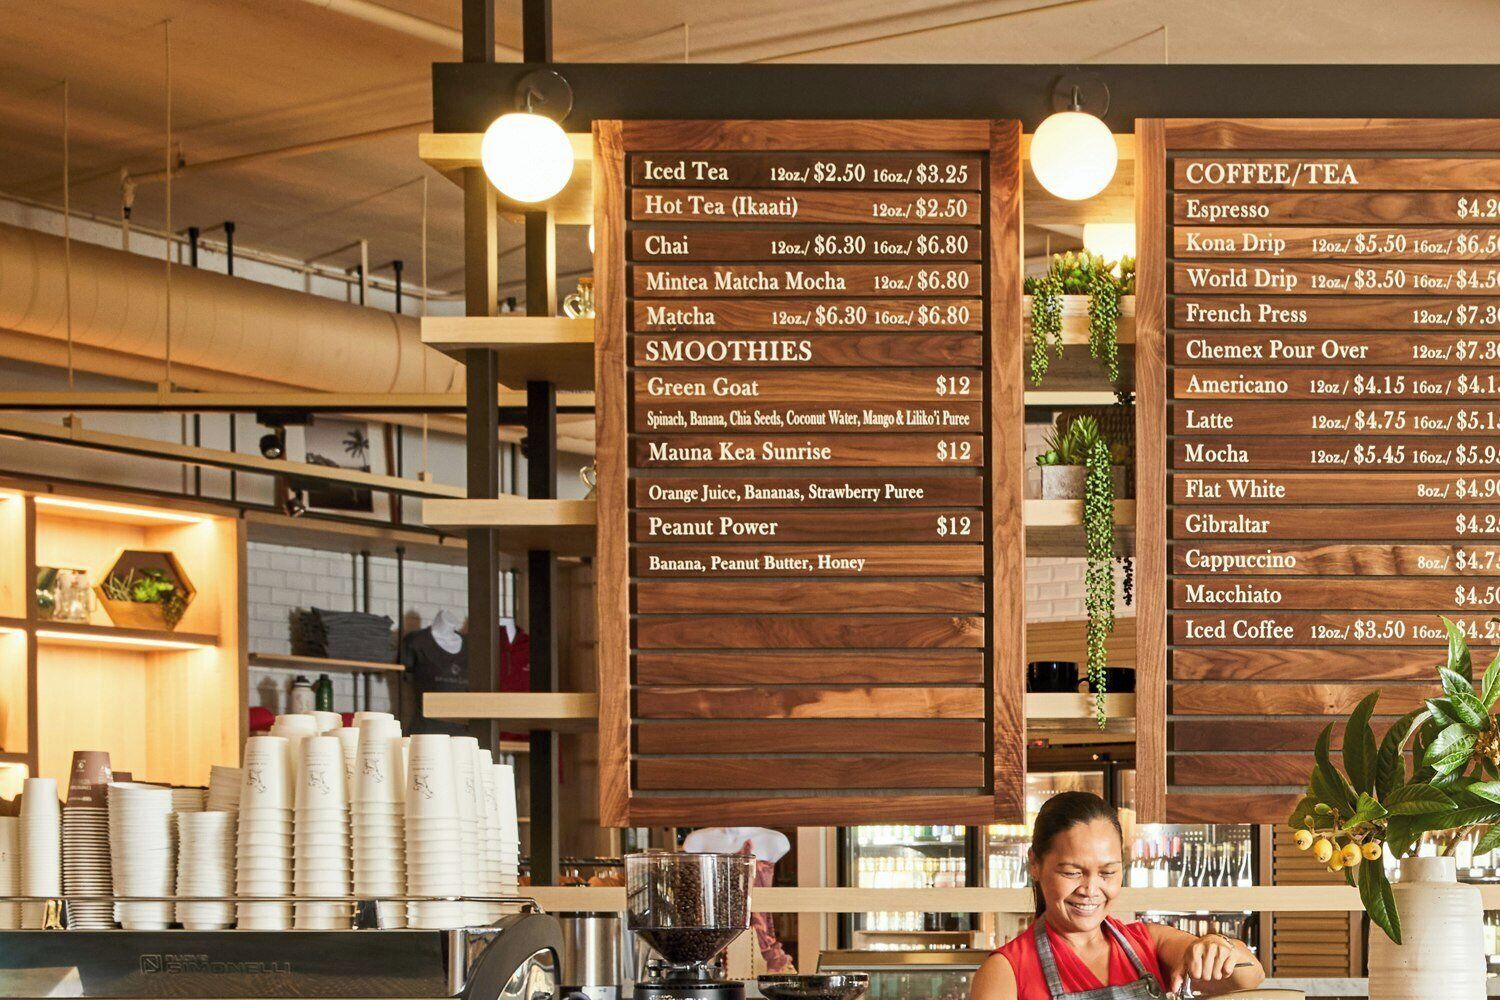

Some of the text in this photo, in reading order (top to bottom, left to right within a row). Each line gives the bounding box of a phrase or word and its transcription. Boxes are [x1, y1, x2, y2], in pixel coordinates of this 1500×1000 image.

[645, 161, 685, 180] Iced
[692, 162, 729, 180] Tea
[814, 162, 865, 183] $2.50
[917, 163, 967, 184] $3.25
[1187, 163, 1359, 186] COFFEE/TEA
[645, 195, 682, 214] Hot
[688, 196, 725, 214] Tea
[732, 196, 798, 217] (Ikaati)
[916, 197, 967, 218] $2.50
[1187, 200, 1269, 222] Espresso
[645, 236, 688, 254] Chai
[815, 235, 865, 255] $6.30
[917, 234, 968, 255] $6.80
[1187, 233, 1235, 251] Kona
[1242, 233, 1285, 255] Drip
[1355, 233, 1406, 254] $5.50
[647, 272, 708, 290] Mintea
[715, 272, 779, 290] Matcha
[786, 271, 846, 289] Mocha
[918, 269, 969, 290] $6.80
[1187, 269, 1247, 287] World
[1255, 269, 1297, 291] Drip
[1355, 269, 1405, 289] $3.50
[647, 306, 715, 324] Matcha
[816, 305, 866, 326] $6.30
[918, 305, 969, 326] $6.80
[1187, 304, 1251, 322] French
[1259, 304, 1307, 322] Press
[646, 341, 812, 361] SMOOTHIES
[1187, 340, 1262, 358] Chemex
[1270, 340, 1315, 358] Pour
[1322, 340, 1368, 358] Over
[648, 375, 969, 396] Green Goat $12
[1186, 375, 1288, 393] Americano
[1354, 374, 1404, 395] $4.15
[648, 410, 969, 429] Spinach, Banana, Chia Seeds, Coconut Water, Mango & Liliko'i Puree
[1186, 410, 1233, 428] Latte
[1355, 409, 1405, 430] $4.75
[649, 440, 970, 461] Mauna Kea Sunrise $12
[1185, 444, 1249, 462] Mocha
[1354, 444, 1404, 465] $5.45
[649, 484, 923, 503] Orange Juice, Bananas, Strawberry Puree
[1186, 479, 1221, 497] Flat
[1227, 480, 1285, 497] White
[649, 516, 970, 536] Peanut Power $12
[1186, 514, 1270, 533] Gibraltar
[650, 555, 865, 572] Banana, Peanut Butter, Honey
[1186, 549, 1296, 571] Cappuccino
[1186, 585, 1281, 603] Macchiato
[1186, 620, 1226, 638] Iced
[1233, 620, 1293, 638] Coffee
[1354, 619, 1405, 640] $3.50
[167, 962, 291, 974] SIMONELLI
